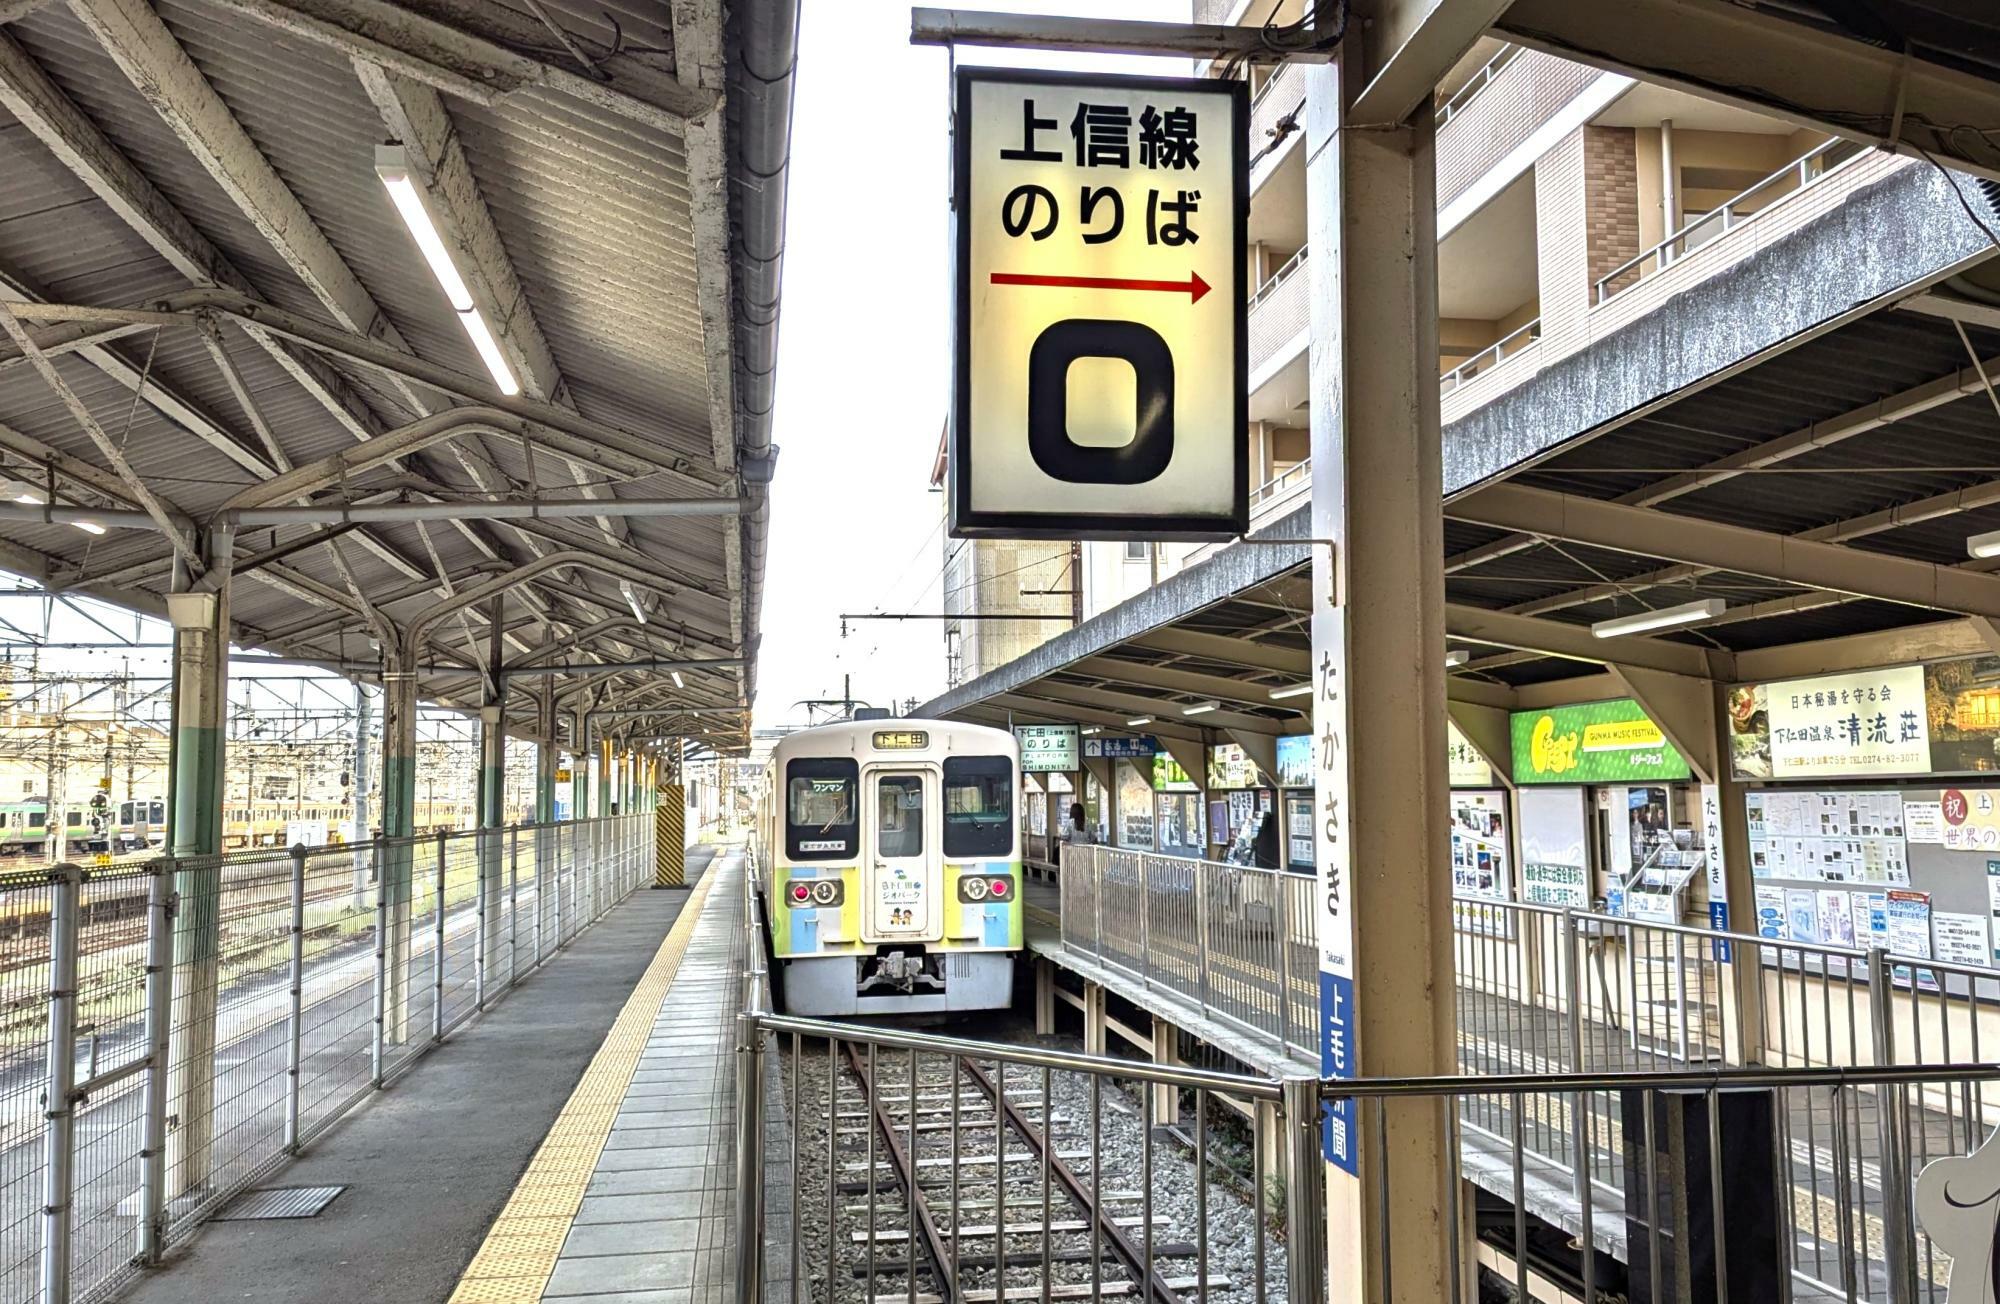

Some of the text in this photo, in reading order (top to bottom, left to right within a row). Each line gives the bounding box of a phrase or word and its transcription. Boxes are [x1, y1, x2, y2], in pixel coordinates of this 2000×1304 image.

[1000, 98, 1201, 171] 上信線
[1001, 183, 1202, 247] のりば
[1028, 318, 1175, 485] 0
[1791, 684, 1892, 709] 日本秘湯を守る会
[878, 733, 923, 745] 下仁田
[1017, 727, 1046, 738] 下仁田
[1027, 738, 1067, 749] のりば
[813, 783, 844, 793] ワンマン
[1319, 649, 1340, 917] たかさき
[1944, 795, 1964, 819] 祝
[1706, 797, 1720, 884] たかさき
[1945, 827, 1997, 848] 世界の
